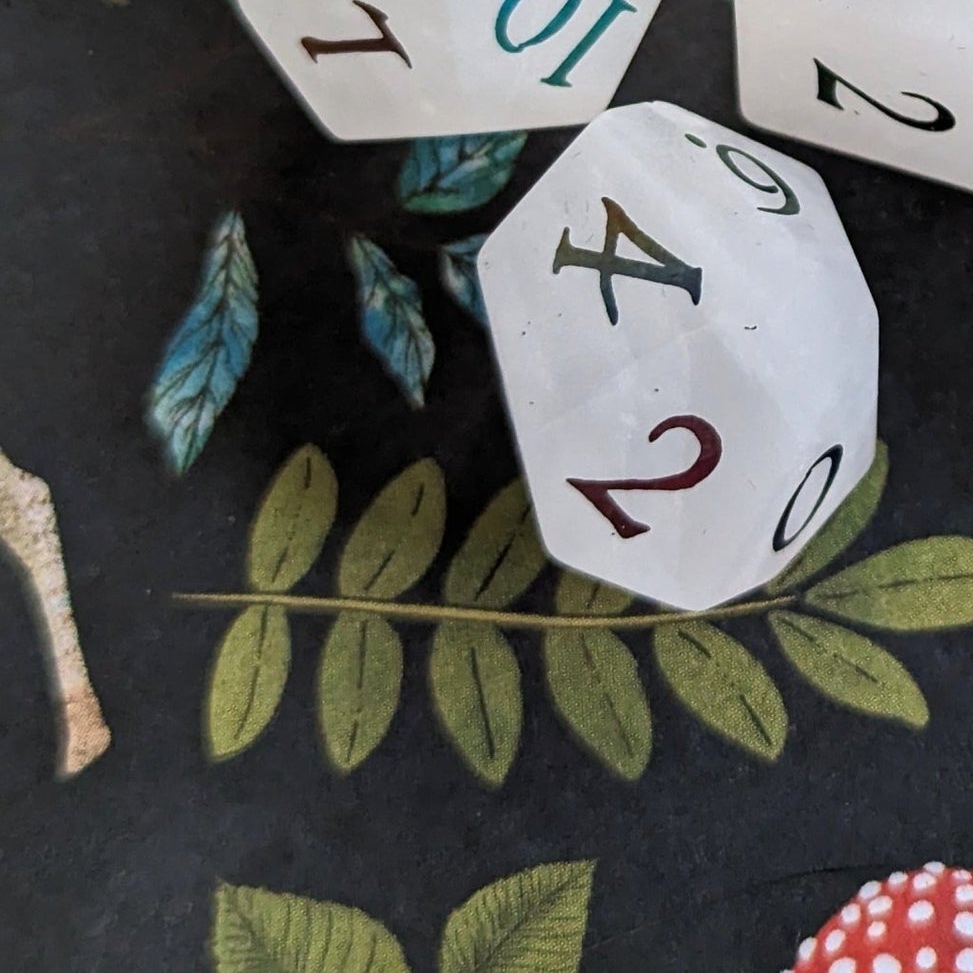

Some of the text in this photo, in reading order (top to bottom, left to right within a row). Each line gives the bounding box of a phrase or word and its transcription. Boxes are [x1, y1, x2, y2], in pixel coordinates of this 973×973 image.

[813, 58, 956, 133] 2
[552, 197, 702, 326] 4
[566, 415, 722, 540] 2
[772, 444, 844, 552] 0
